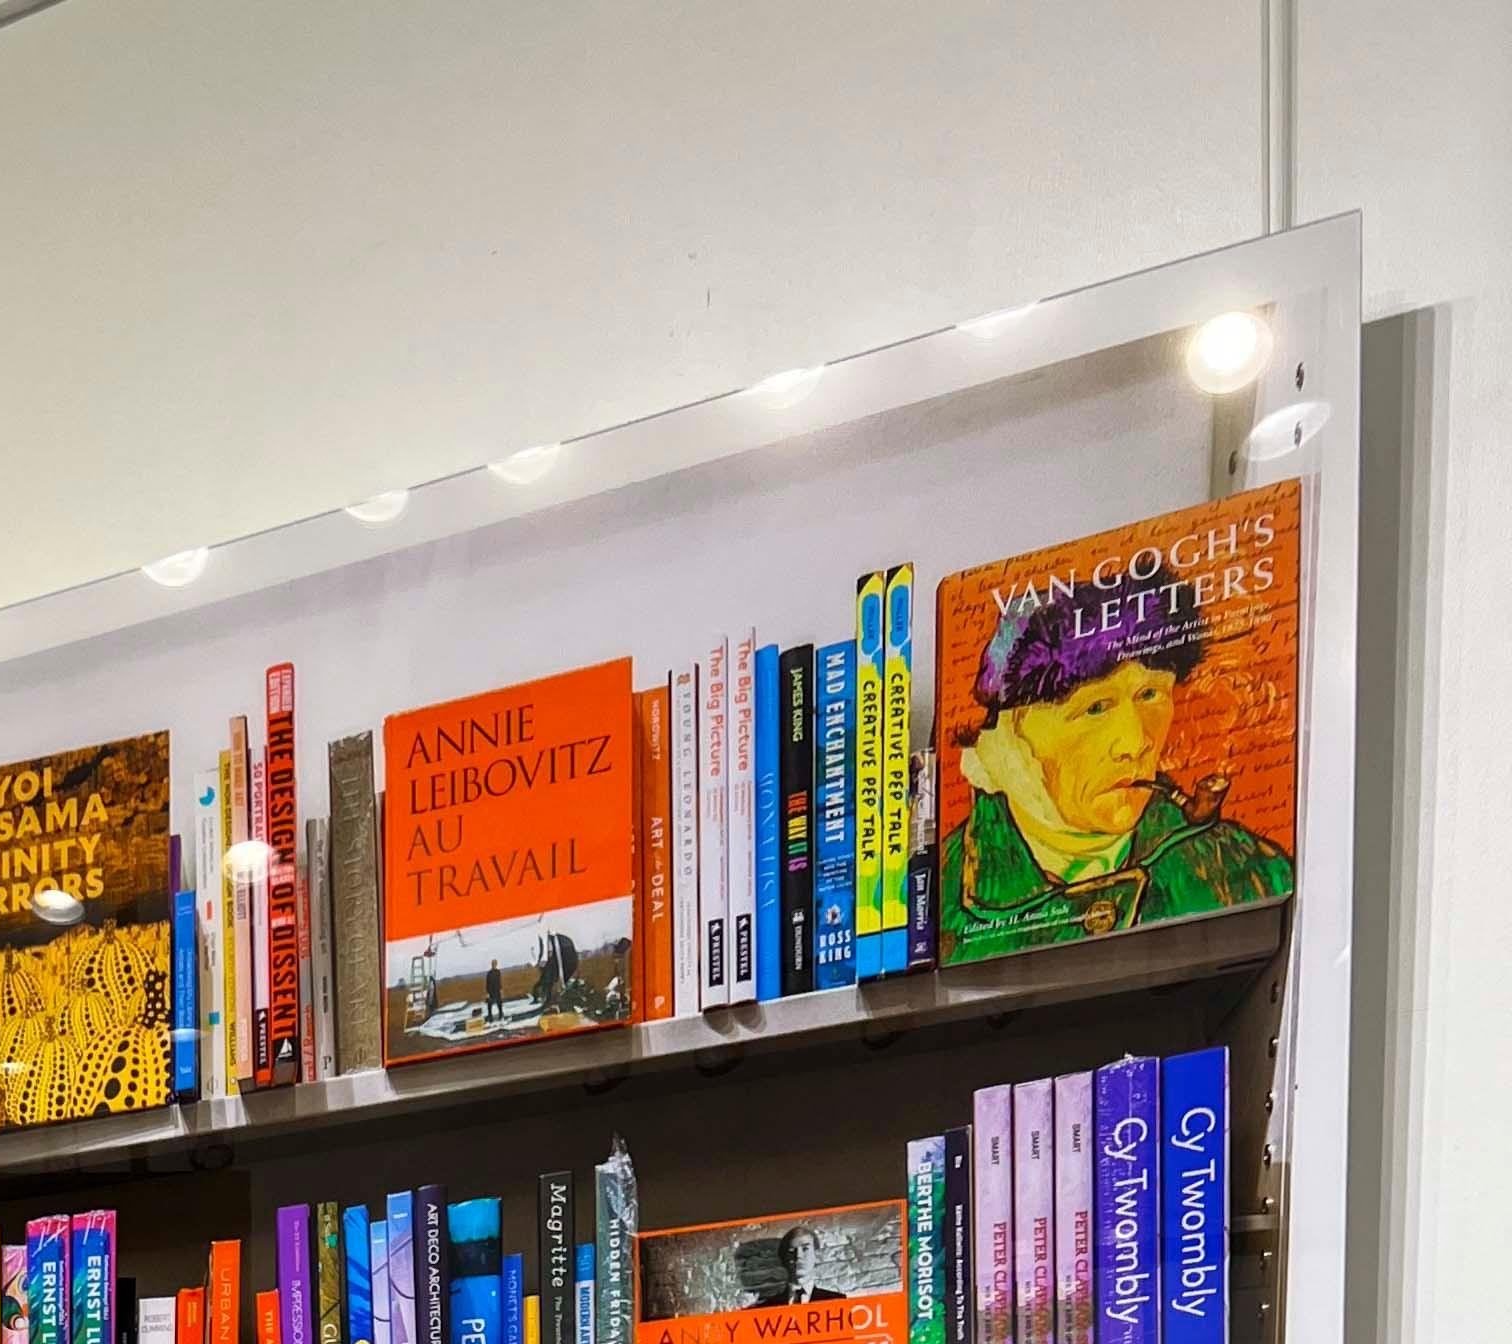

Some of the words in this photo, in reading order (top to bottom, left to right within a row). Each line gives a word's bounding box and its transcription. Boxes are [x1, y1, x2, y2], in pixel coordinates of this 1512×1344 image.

[991, 568, 1076, 617] VAN
[1093, 513, 1275, 591] GOGH'S
[1071, 557, 1274, 641] LETTERS
[709, 646, 724, 677] The
[737, 639, 752, 672] The
[707, 682, 723, 710] Big
[735, 675, 752, 704] Big
[790, 668, 804, 707] JAMES
[268, 712, 294, 761] THE
[405, 704, 534, 769] ANNIE
[736, 708, 752, 771] Picture
[791, 709, 803, 742] KING
[862, 680, 877, 769] CREATIVE
[890, 673, 905, 761] CREATIVE
[709, 714, 723, 777] Picture
[410, 734, 612, 815] LEIBOVITZ
[861, 778, 876, 806] PEP
[889, 771, 904, 801] PEP
[270, 766, 295, 865] DESIGN
[788, 791, 807, 814] THE
[406, 815, 464, 861] AU
[788, 816, 807, 841] WAY
[788, 842, 807, 855] IT
[862, 814, 876, 861] TALK
[888, 808, 903, 855] TALK
[406, 837, 586, 906] TRAVAIL
[788, 857, 807, 871] IS
[271, 883, 296, 919] OF
[272, 927, 297, 1038] DISSENT
[1104, 1117, 1148, 1162] Cy
[1170, 1106, 1216, 1153] Cy
[916, 1162, 933, 1232] BERTHE
[546, 1183, 567, 1288] Magritte
[1105, 1168, 1149, 1324] Twombly
[1172, 1158, 1217, 1317] Twombly
[42, 1260, 56, 1327] ERNST
[87, 1255, 101, 1321] ERNST
[217, 1267, 233, 1340] URBAN
[917, 1239, 934, 1321] MORISOT
[754, 1303, 888, 1339] WARHOL
